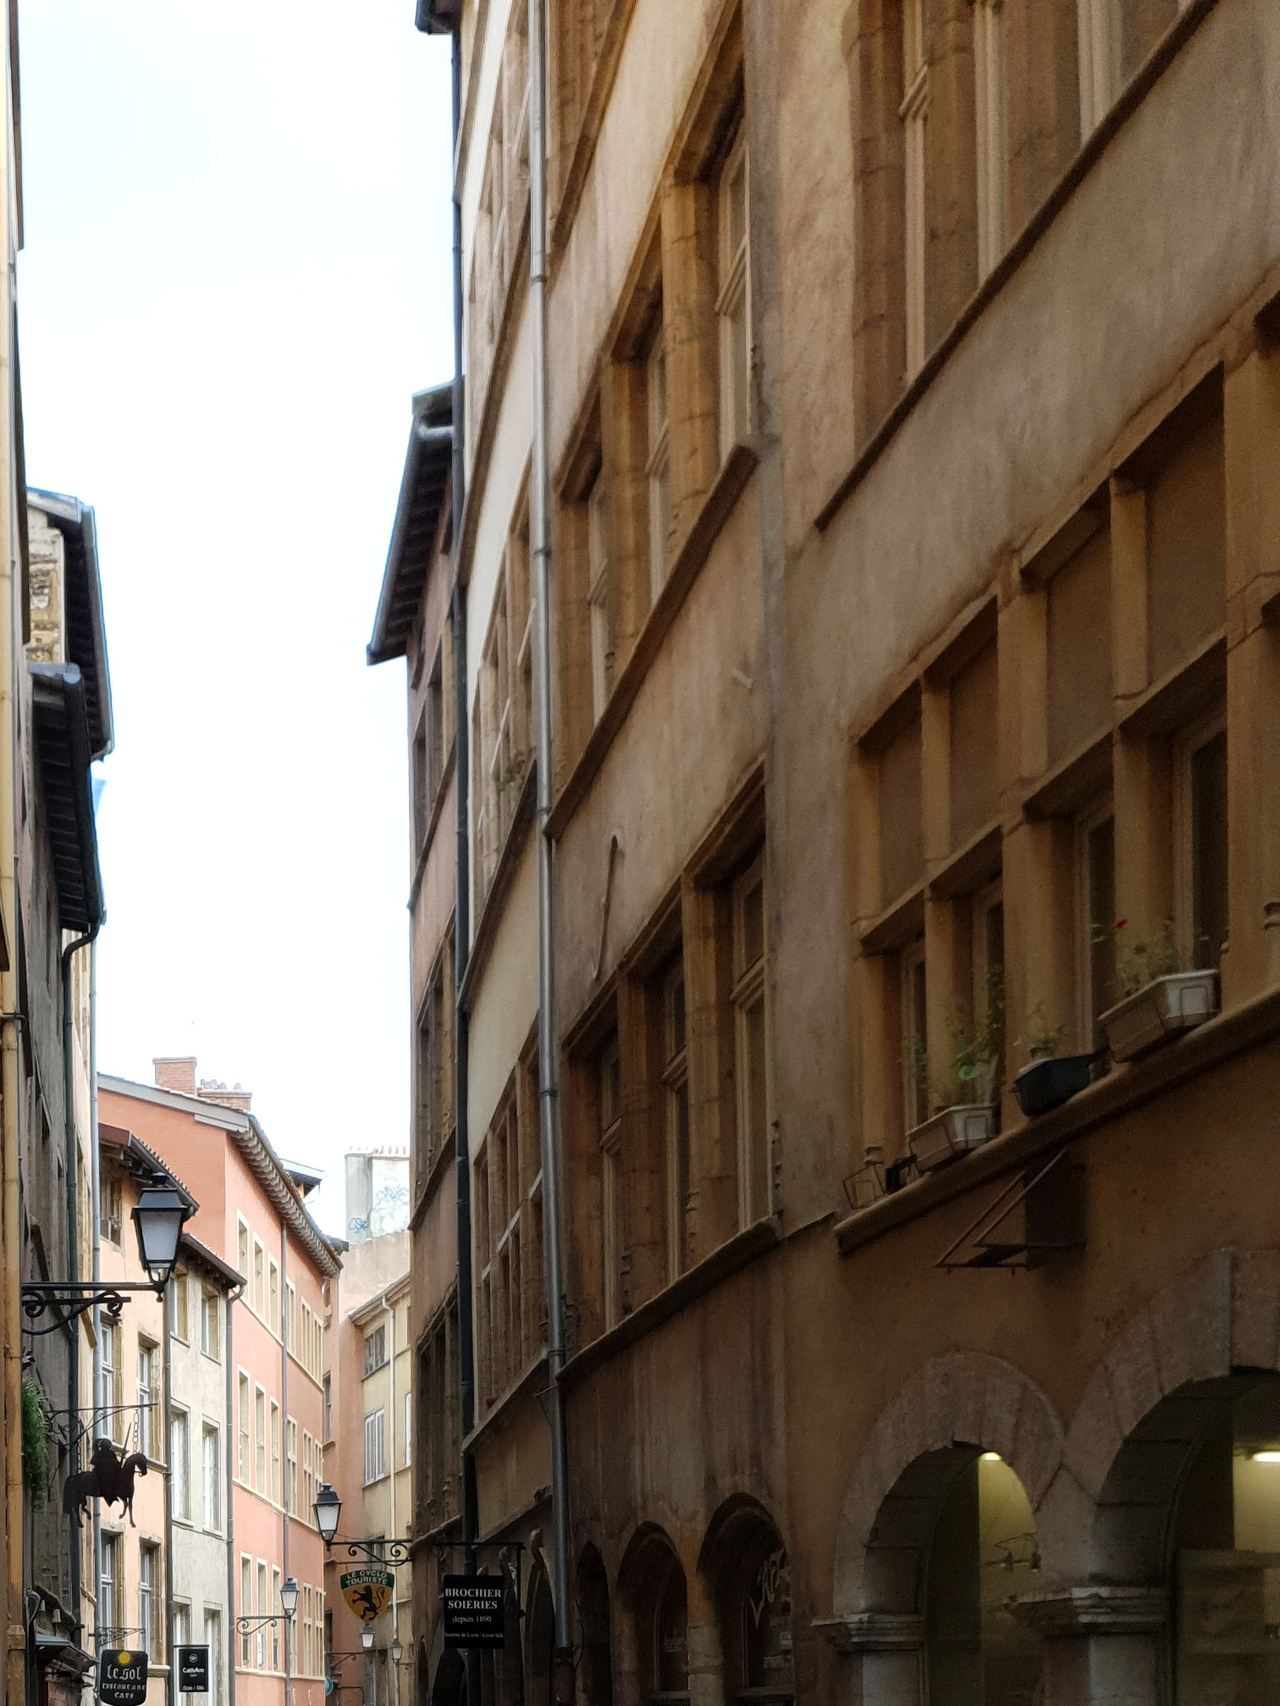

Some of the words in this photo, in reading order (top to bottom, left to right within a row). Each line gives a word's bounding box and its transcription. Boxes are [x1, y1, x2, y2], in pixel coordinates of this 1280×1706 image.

[360, 1570, 387, 1578] CYCLO
[346, 1577, 387, 1586] TOURISTE
[445, 1588, 502, 1598] BROCHIER
[448, 1600, 498, 1609] SOIERIES
[452, 1616, 474, 1624] depuis
